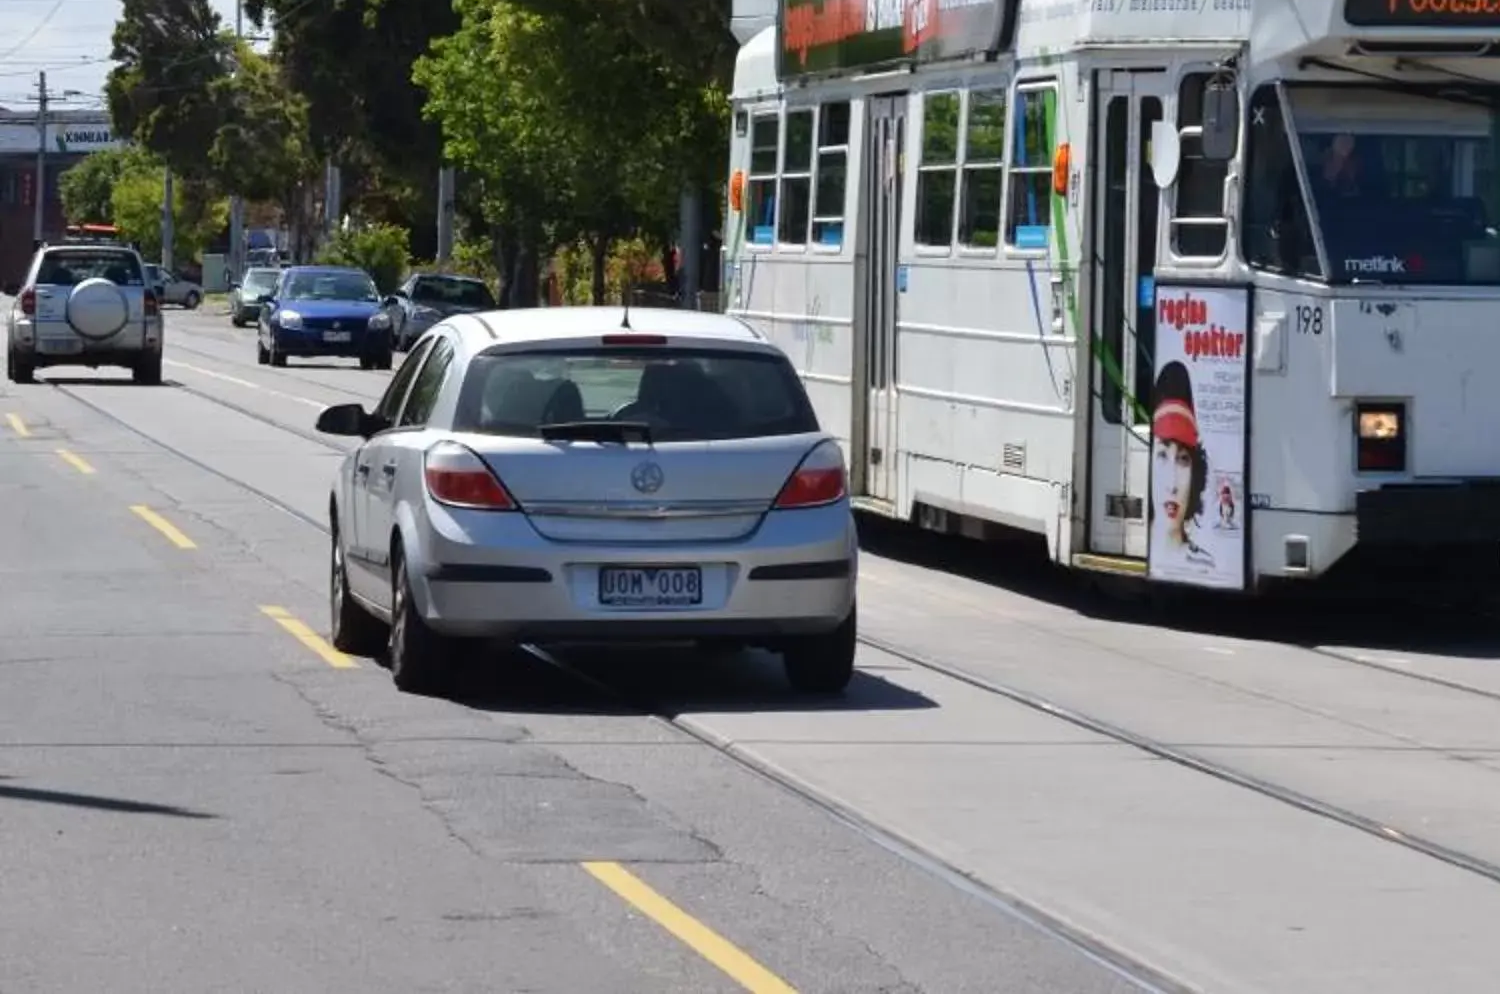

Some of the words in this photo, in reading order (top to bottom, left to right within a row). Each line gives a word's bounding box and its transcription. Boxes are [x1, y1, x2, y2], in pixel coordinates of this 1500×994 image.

[1344, 255, 1405, 273] metlink
[1159, 292, 1207, 331] regina
[1296, 305, 1323, 335] 198
[658, 571, 698, 595] 008
